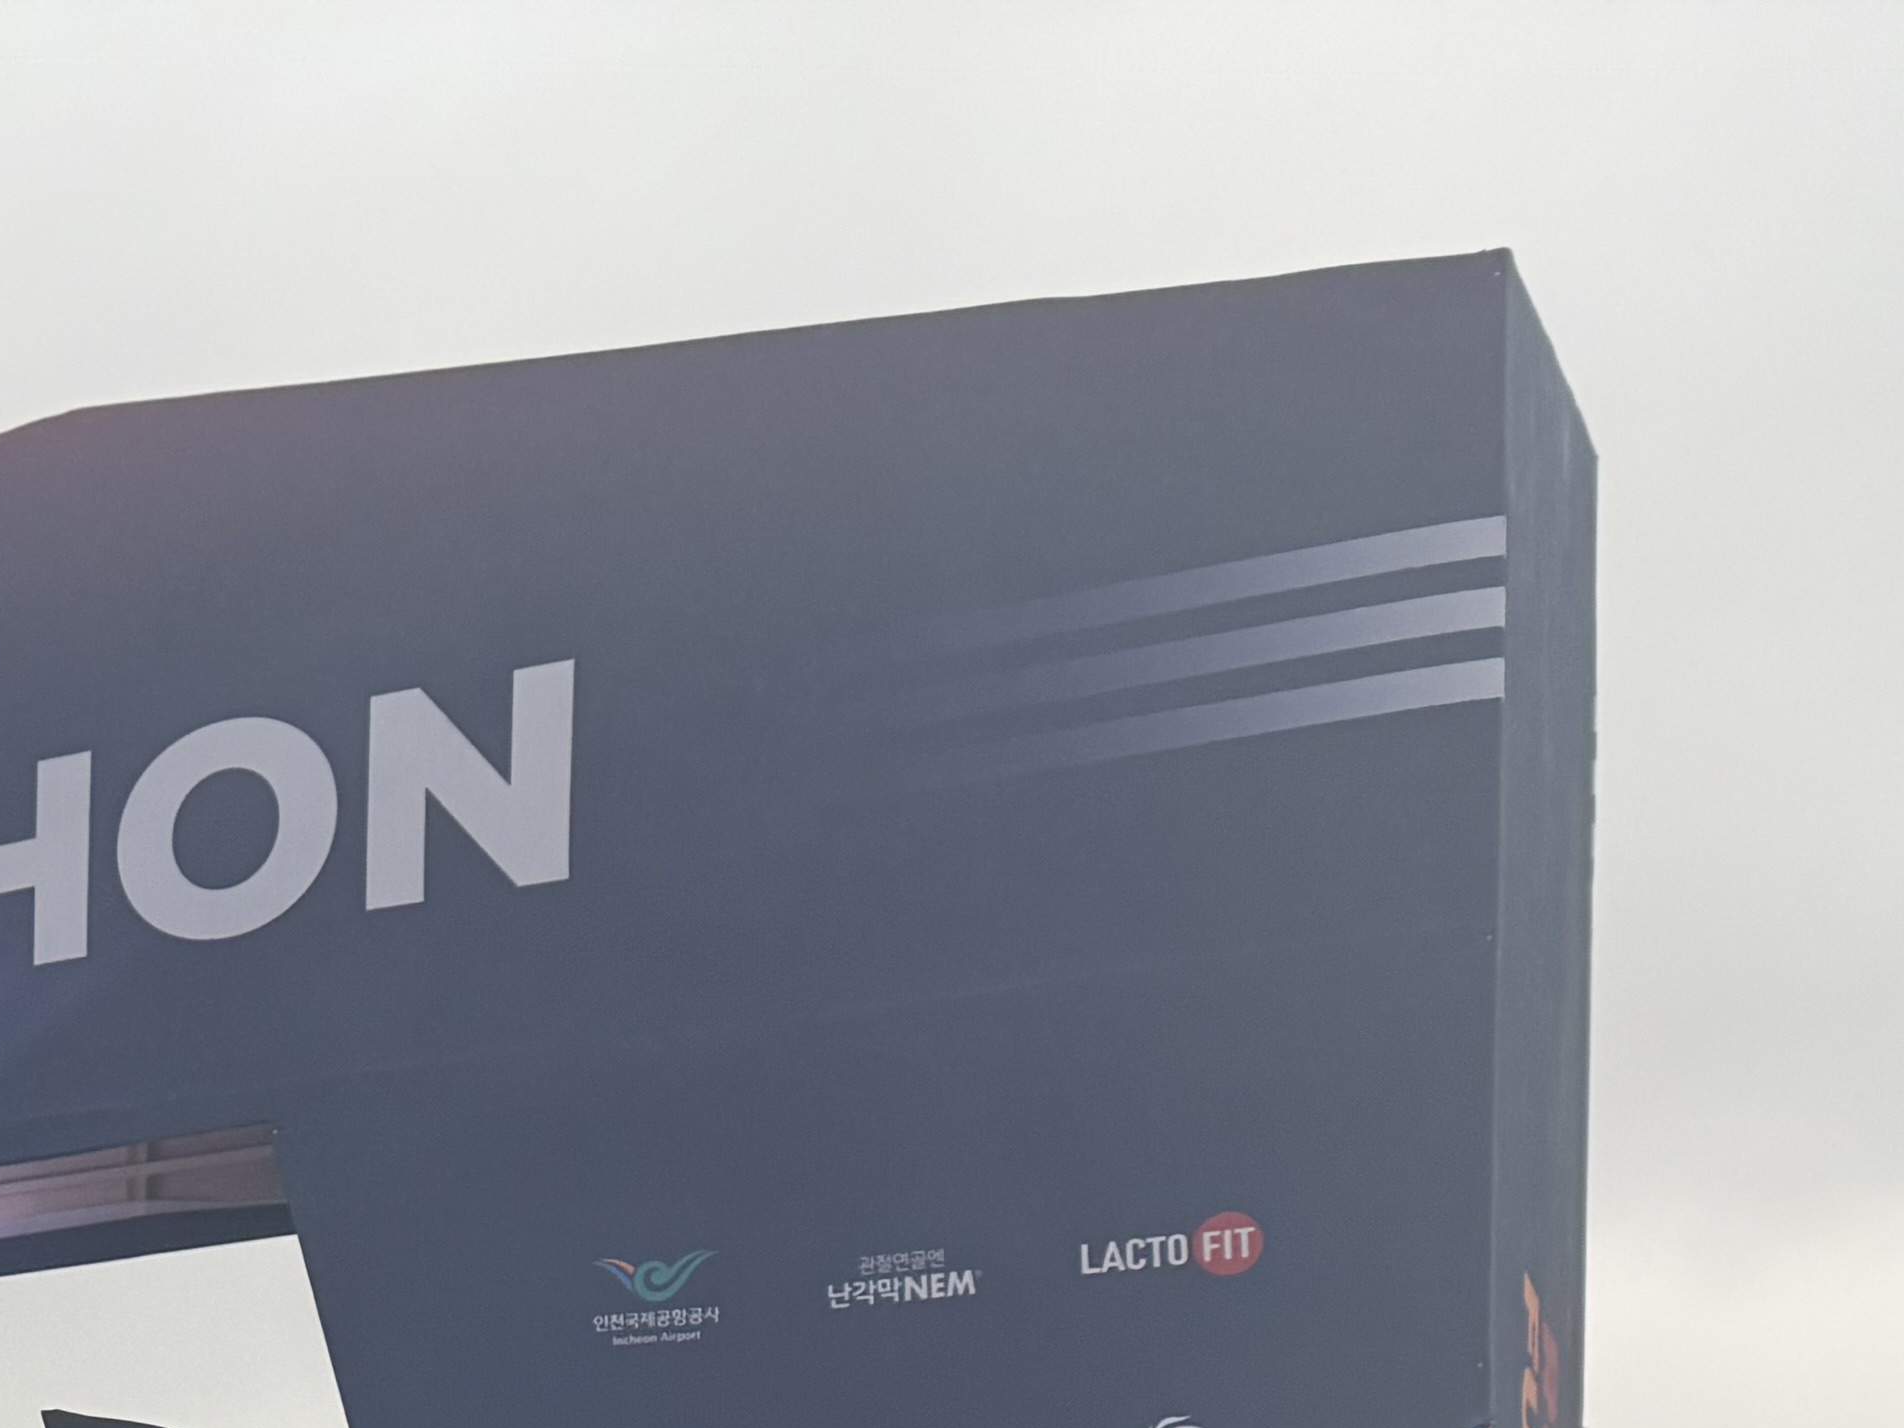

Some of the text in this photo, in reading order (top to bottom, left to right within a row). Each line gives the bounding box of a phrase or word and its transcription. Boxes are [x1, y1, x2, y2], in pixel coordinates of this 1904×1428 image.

[1081, 1227, 1256, 1275] LACTO FIT
[592, 1306, 721, 1332] 인천국제공항공사
